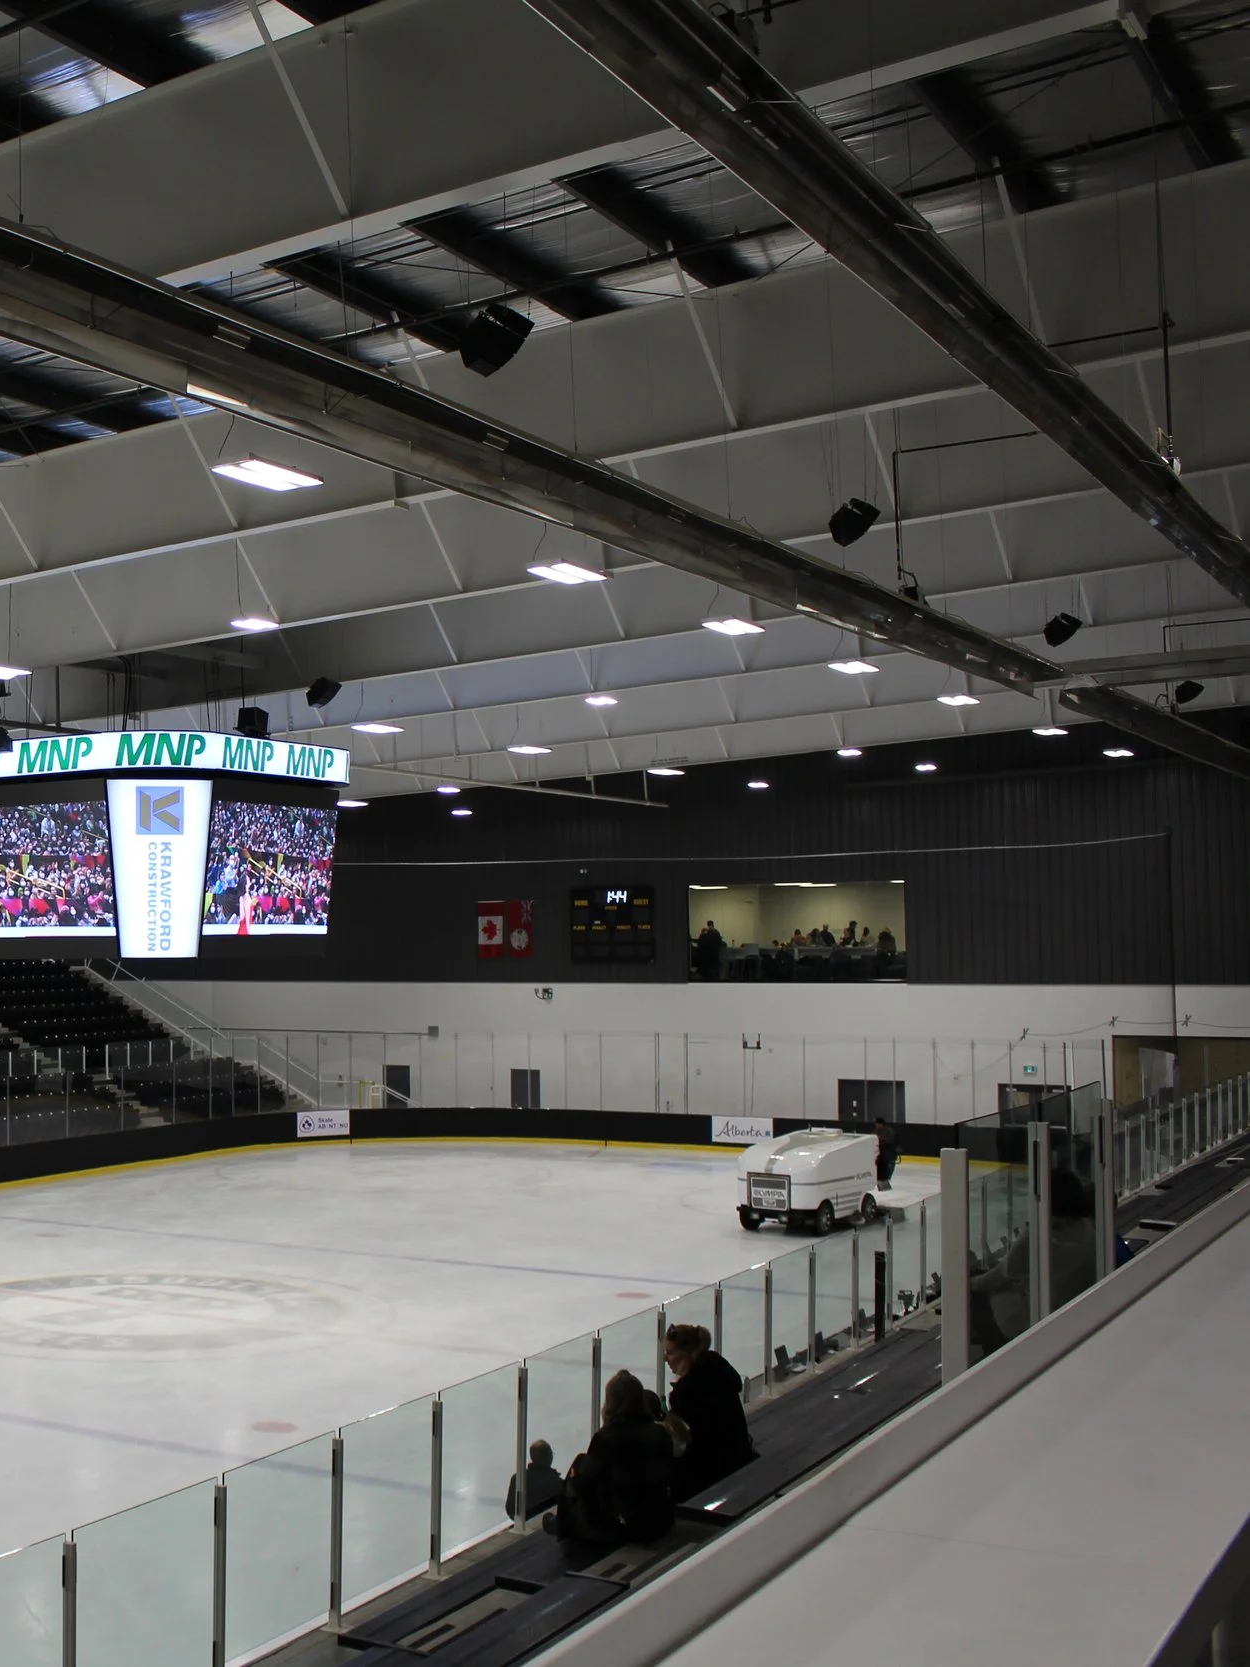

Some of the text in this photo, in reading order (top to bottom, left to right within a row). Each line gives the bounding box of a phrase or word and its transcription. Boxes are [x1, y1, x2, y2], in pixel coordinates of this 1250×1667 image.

[17, 737, 93, 774] MNP
[115, 733, 206, 766] MNP
[222, 736, 274, 772] MNP
[286, 744, 334, 778] MNP
[147, 841, 157, 952] CONSTRUCTION
[159, 841, 172, 952] KRAWFORD
[715, 1120, 763, 1137] Alberta
